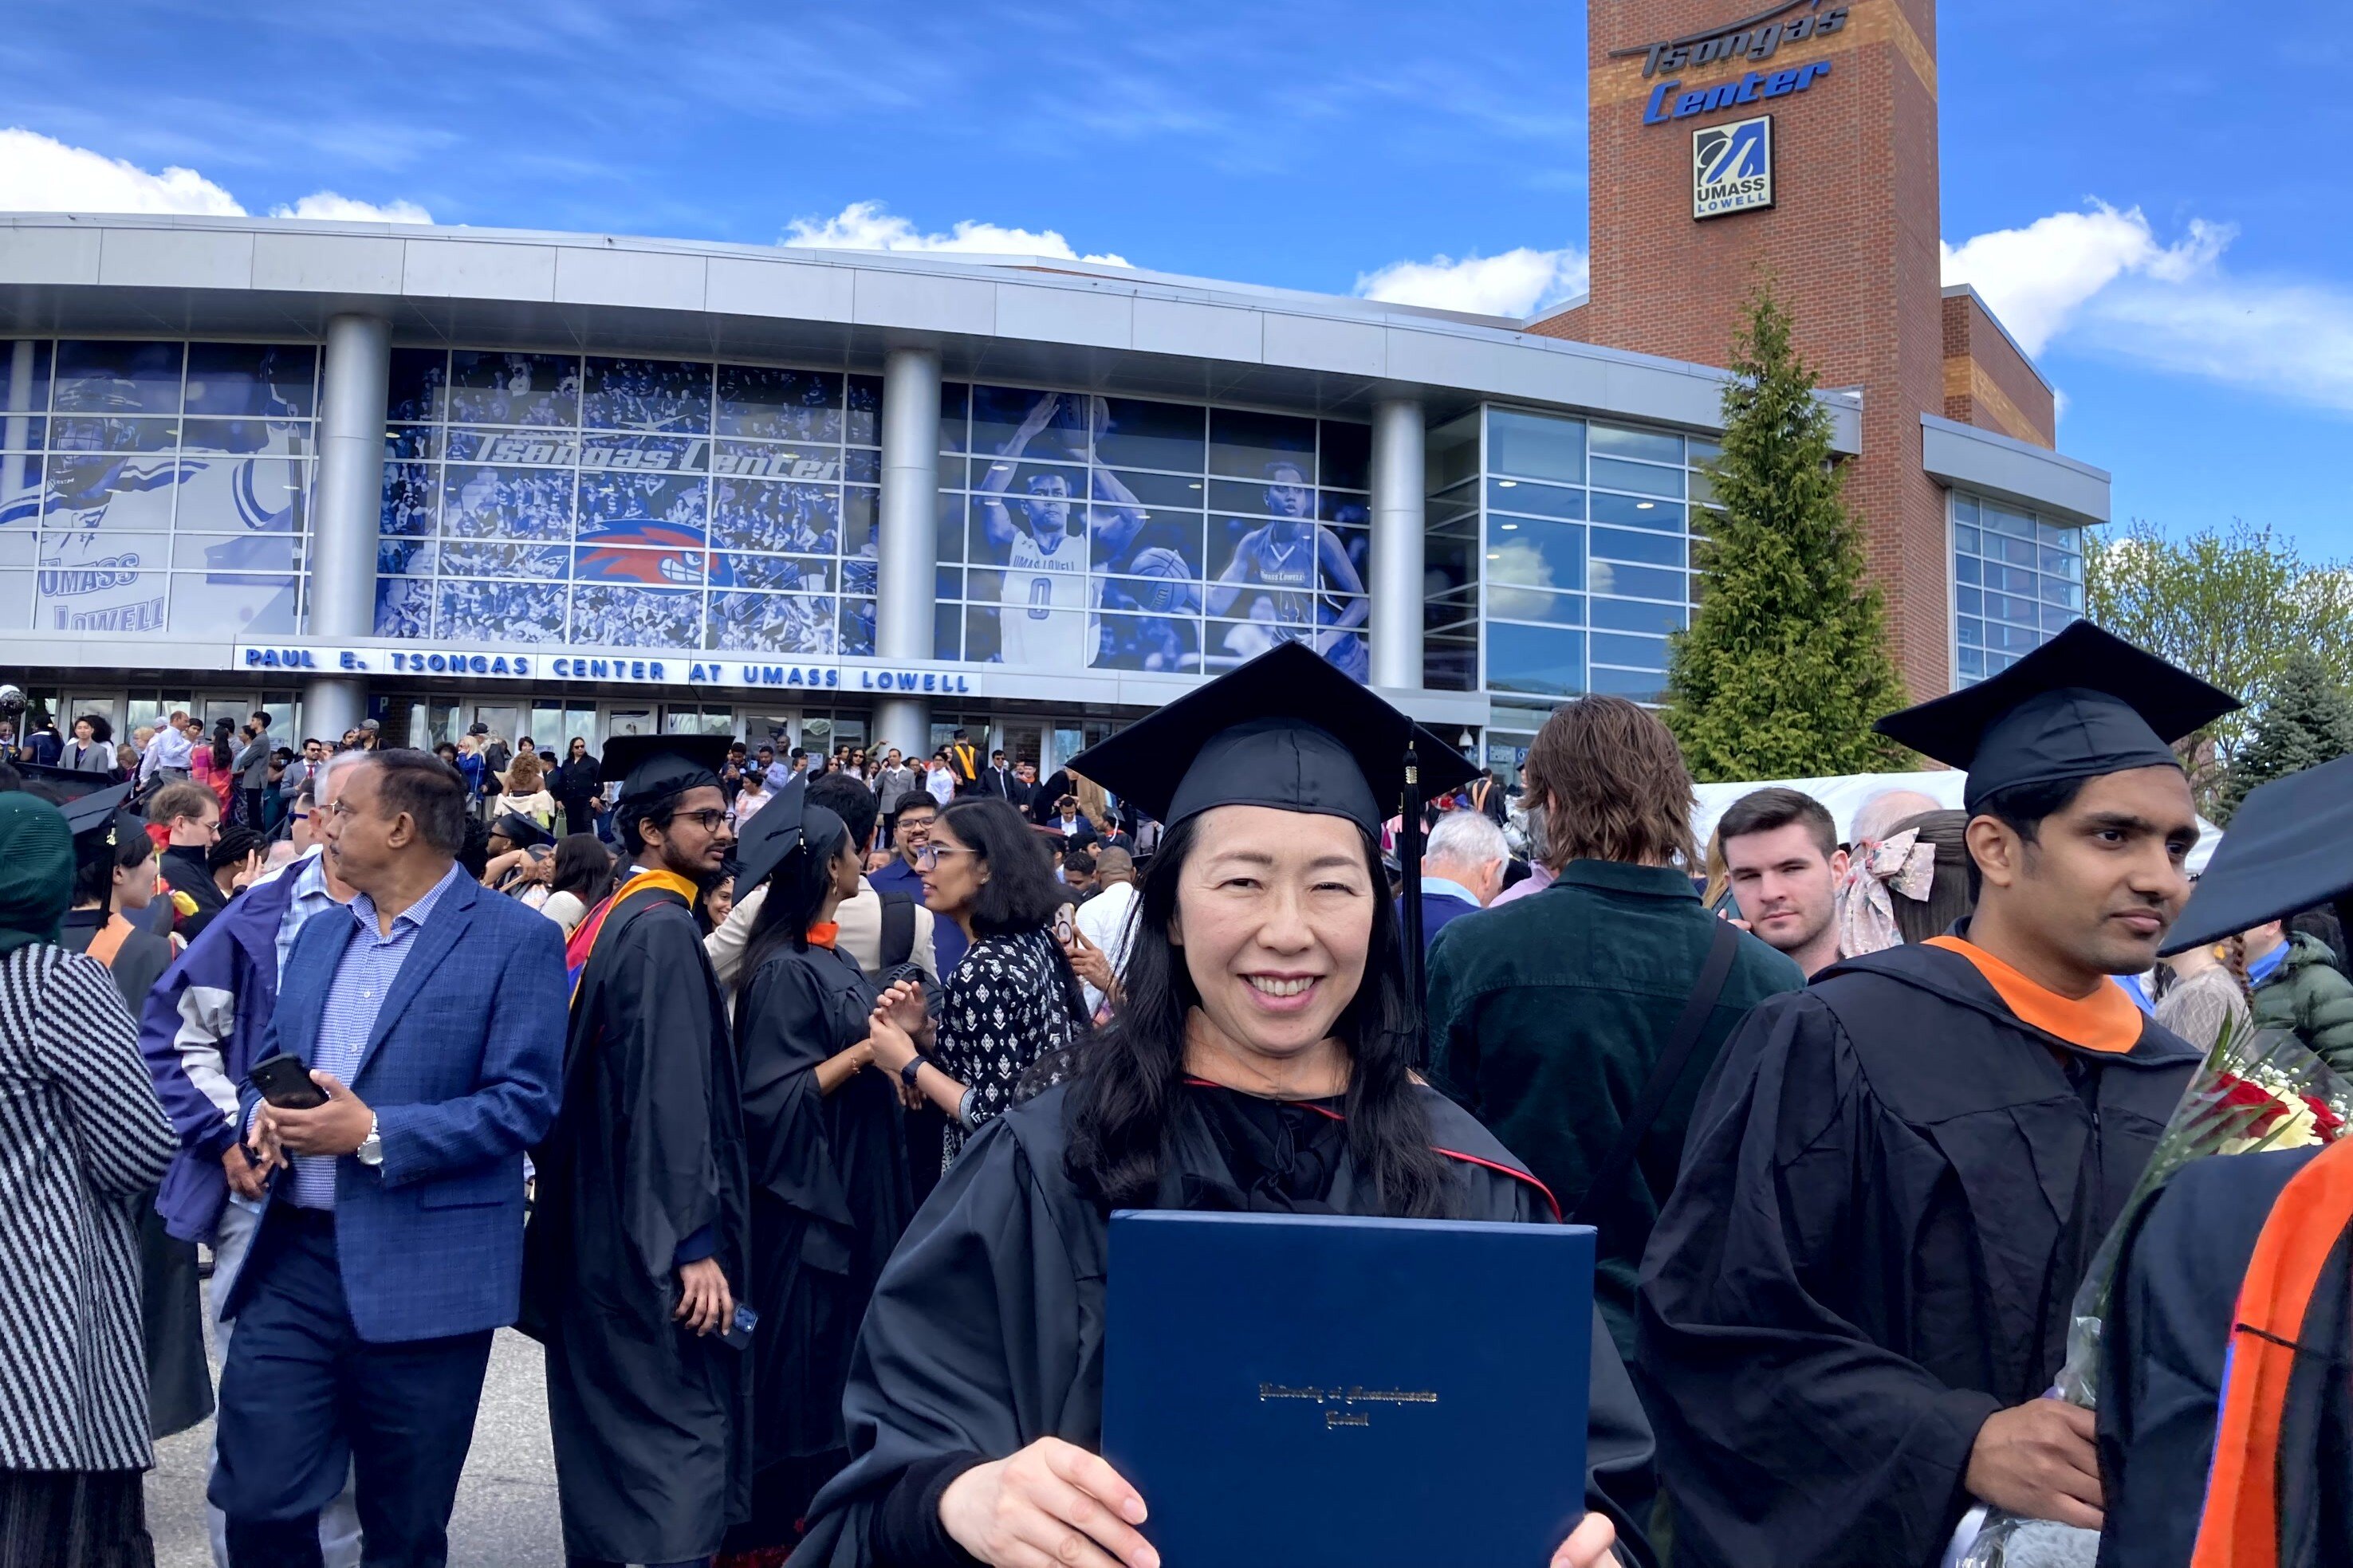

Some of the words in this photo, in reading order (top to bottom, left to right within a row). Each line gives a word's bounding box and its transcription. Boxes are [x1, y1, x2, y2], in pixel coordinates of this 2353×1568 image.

[1608, 7, 1850, 78] Tsongas
[1643, 61, 1832, 125] Center
[1697, 177, 1765, 202] UMASS
[1698, 192, 1765, 214] LOWELL
[458, 431, 673, 474] Tsongas
[39, 552, 140, 598] UMASS
[54, 597, 165, 631] LOWELL
[246, 648, 315, 669] PAUL
[340, 650, 367, 669] E.
[391, 652, 528, 674] TSONGAS
[553, 658, 664, 679] CENTER
[689, 663, 722, 682] AT
[743, 665, 838, 687] UMASS
[863, 670, 970, 692] LOWELL
